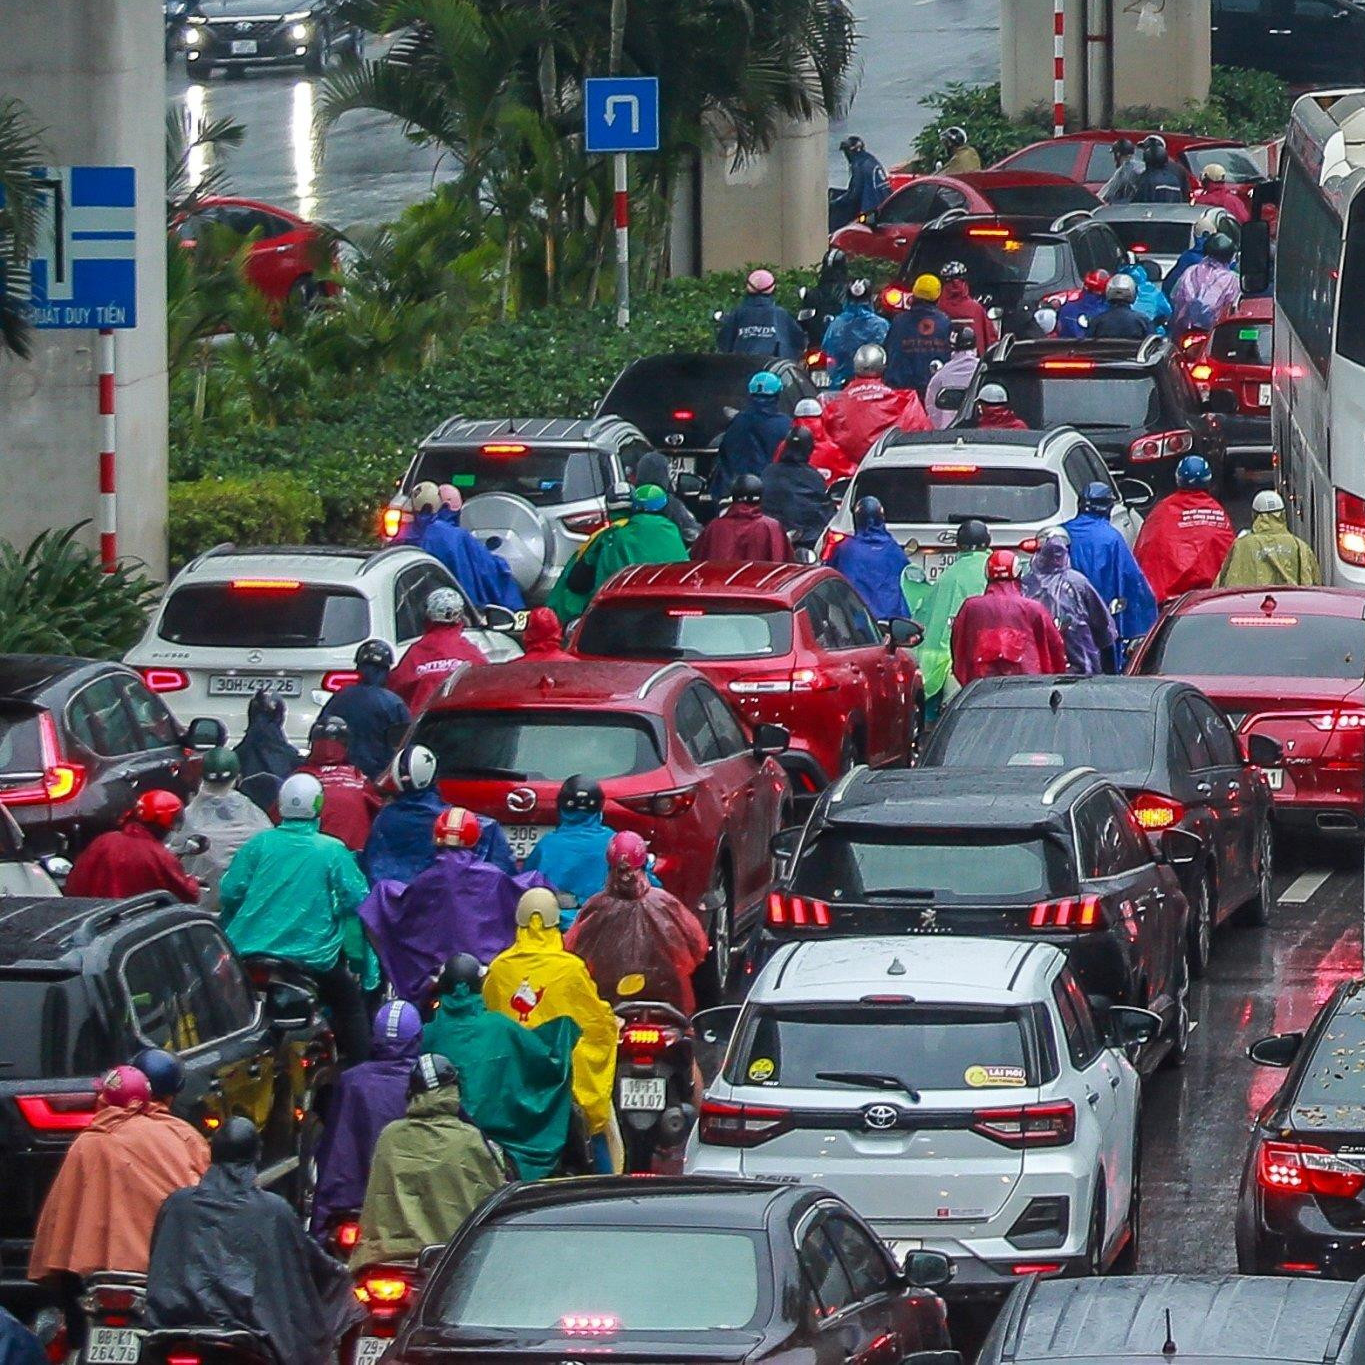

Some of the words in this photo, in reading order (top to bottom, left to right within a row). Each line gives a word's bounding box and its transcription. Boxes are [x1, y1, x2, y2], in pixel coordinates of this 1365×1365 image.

[64, 308, 90, 325] DUY
[96, 302, 126, 325] TIẾN
[509, 826, 538, 842] 30G
